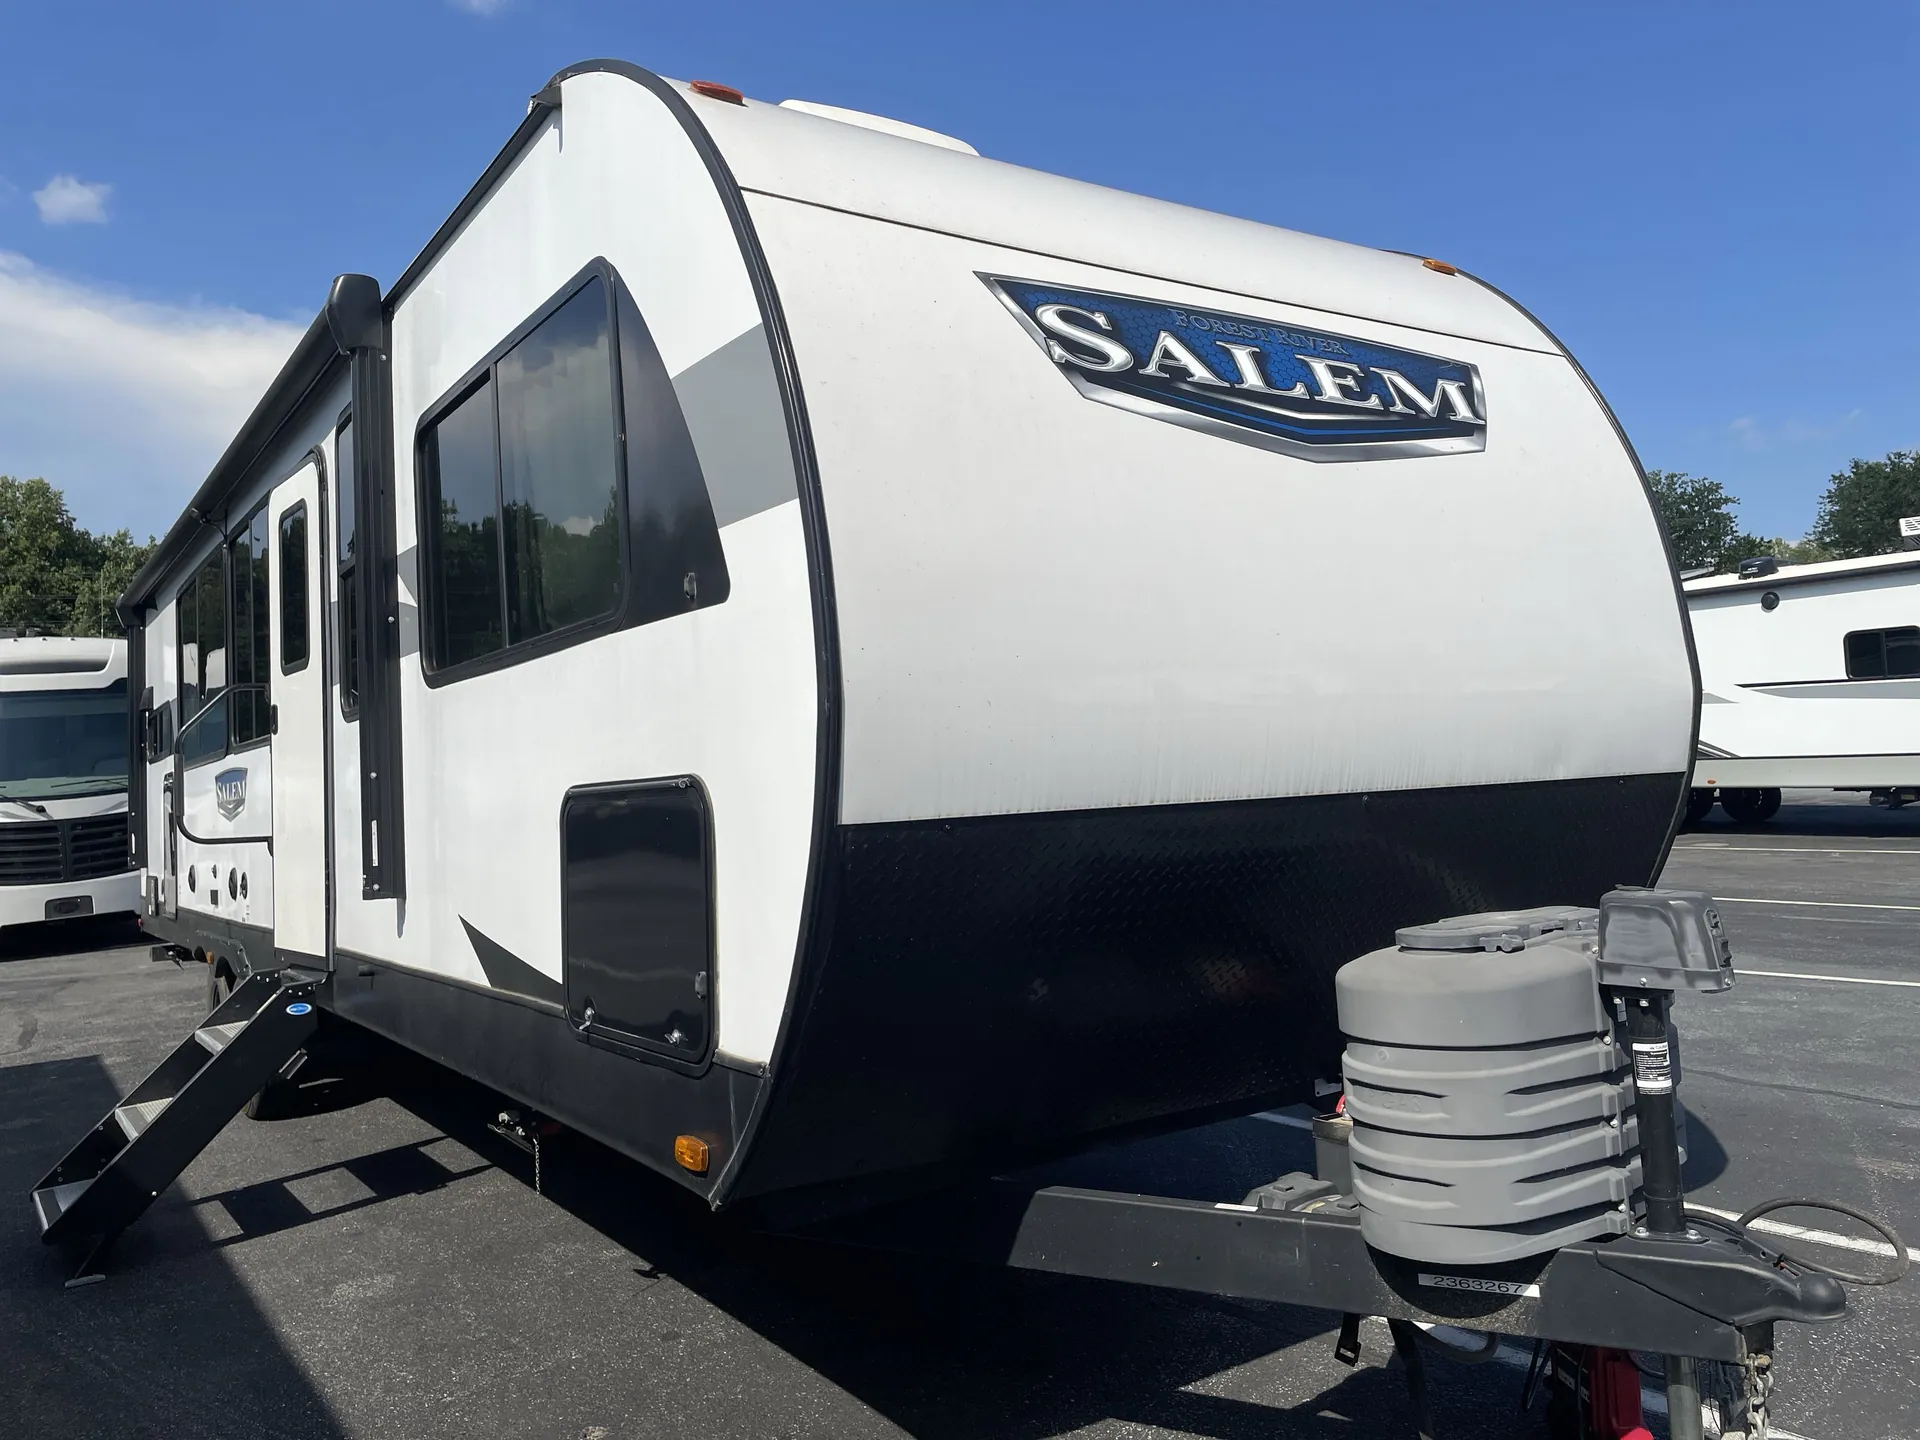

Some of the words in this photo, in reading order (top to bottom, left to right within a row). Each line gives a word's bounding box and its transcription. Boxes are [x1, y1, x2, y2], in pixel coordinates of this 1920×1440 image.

[1167, 308, 1271, 341] FOREST
[1269, 327, 1350, 356] RIVER
[1034, 303, 1487, 425] SALEM
[1433, 1276, 1523, 1294] 2363267
